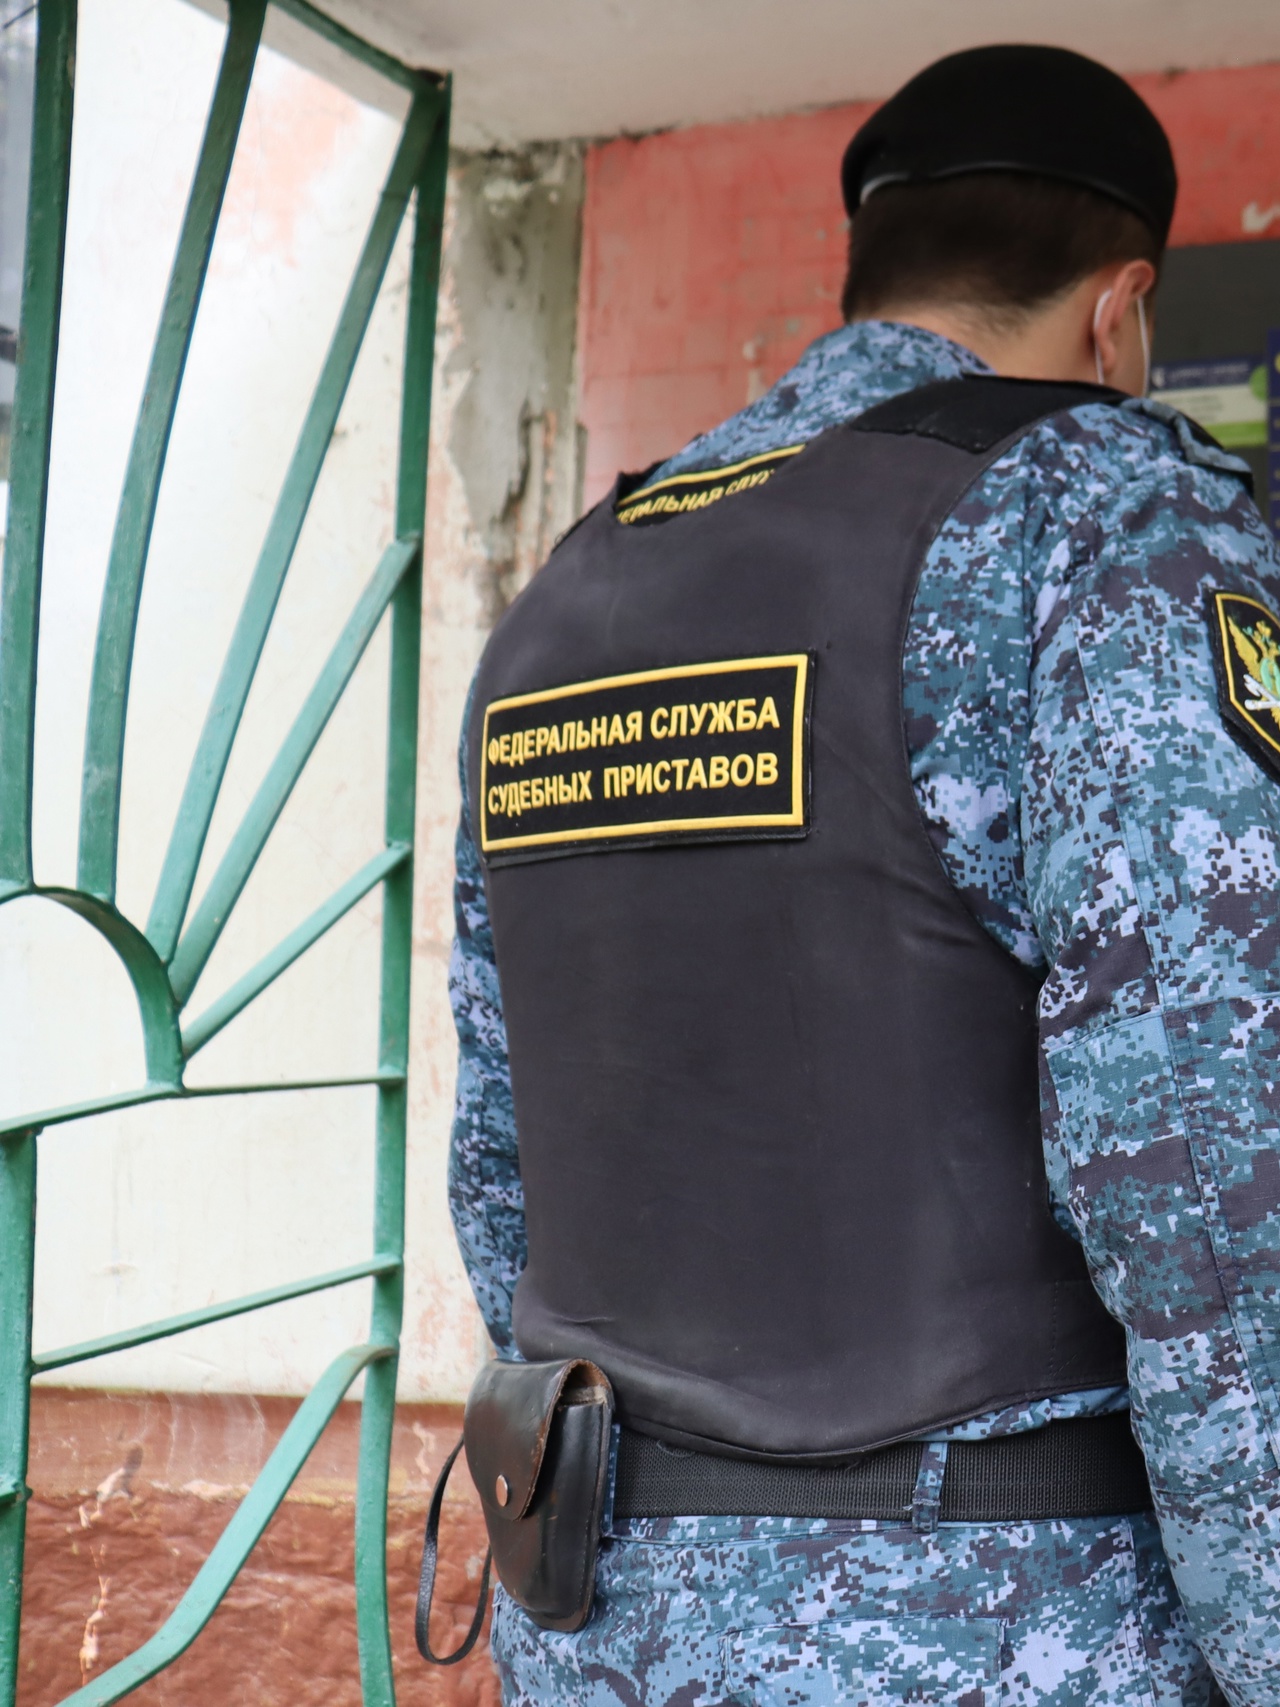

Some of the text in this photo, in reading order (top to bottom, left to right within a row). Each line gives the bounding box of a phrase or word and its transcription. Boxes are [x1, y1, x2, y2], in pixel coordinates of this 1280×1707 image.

[616, 486, 724, 525] ЕРАЛЬНАЯ
[488, 696, 780, 768] ФЕДЕРАЛЬНАЯ СЛУЖБА
[488, 752, 779, 818] СУДЕБНЫХ ПРИСТАВОВ
